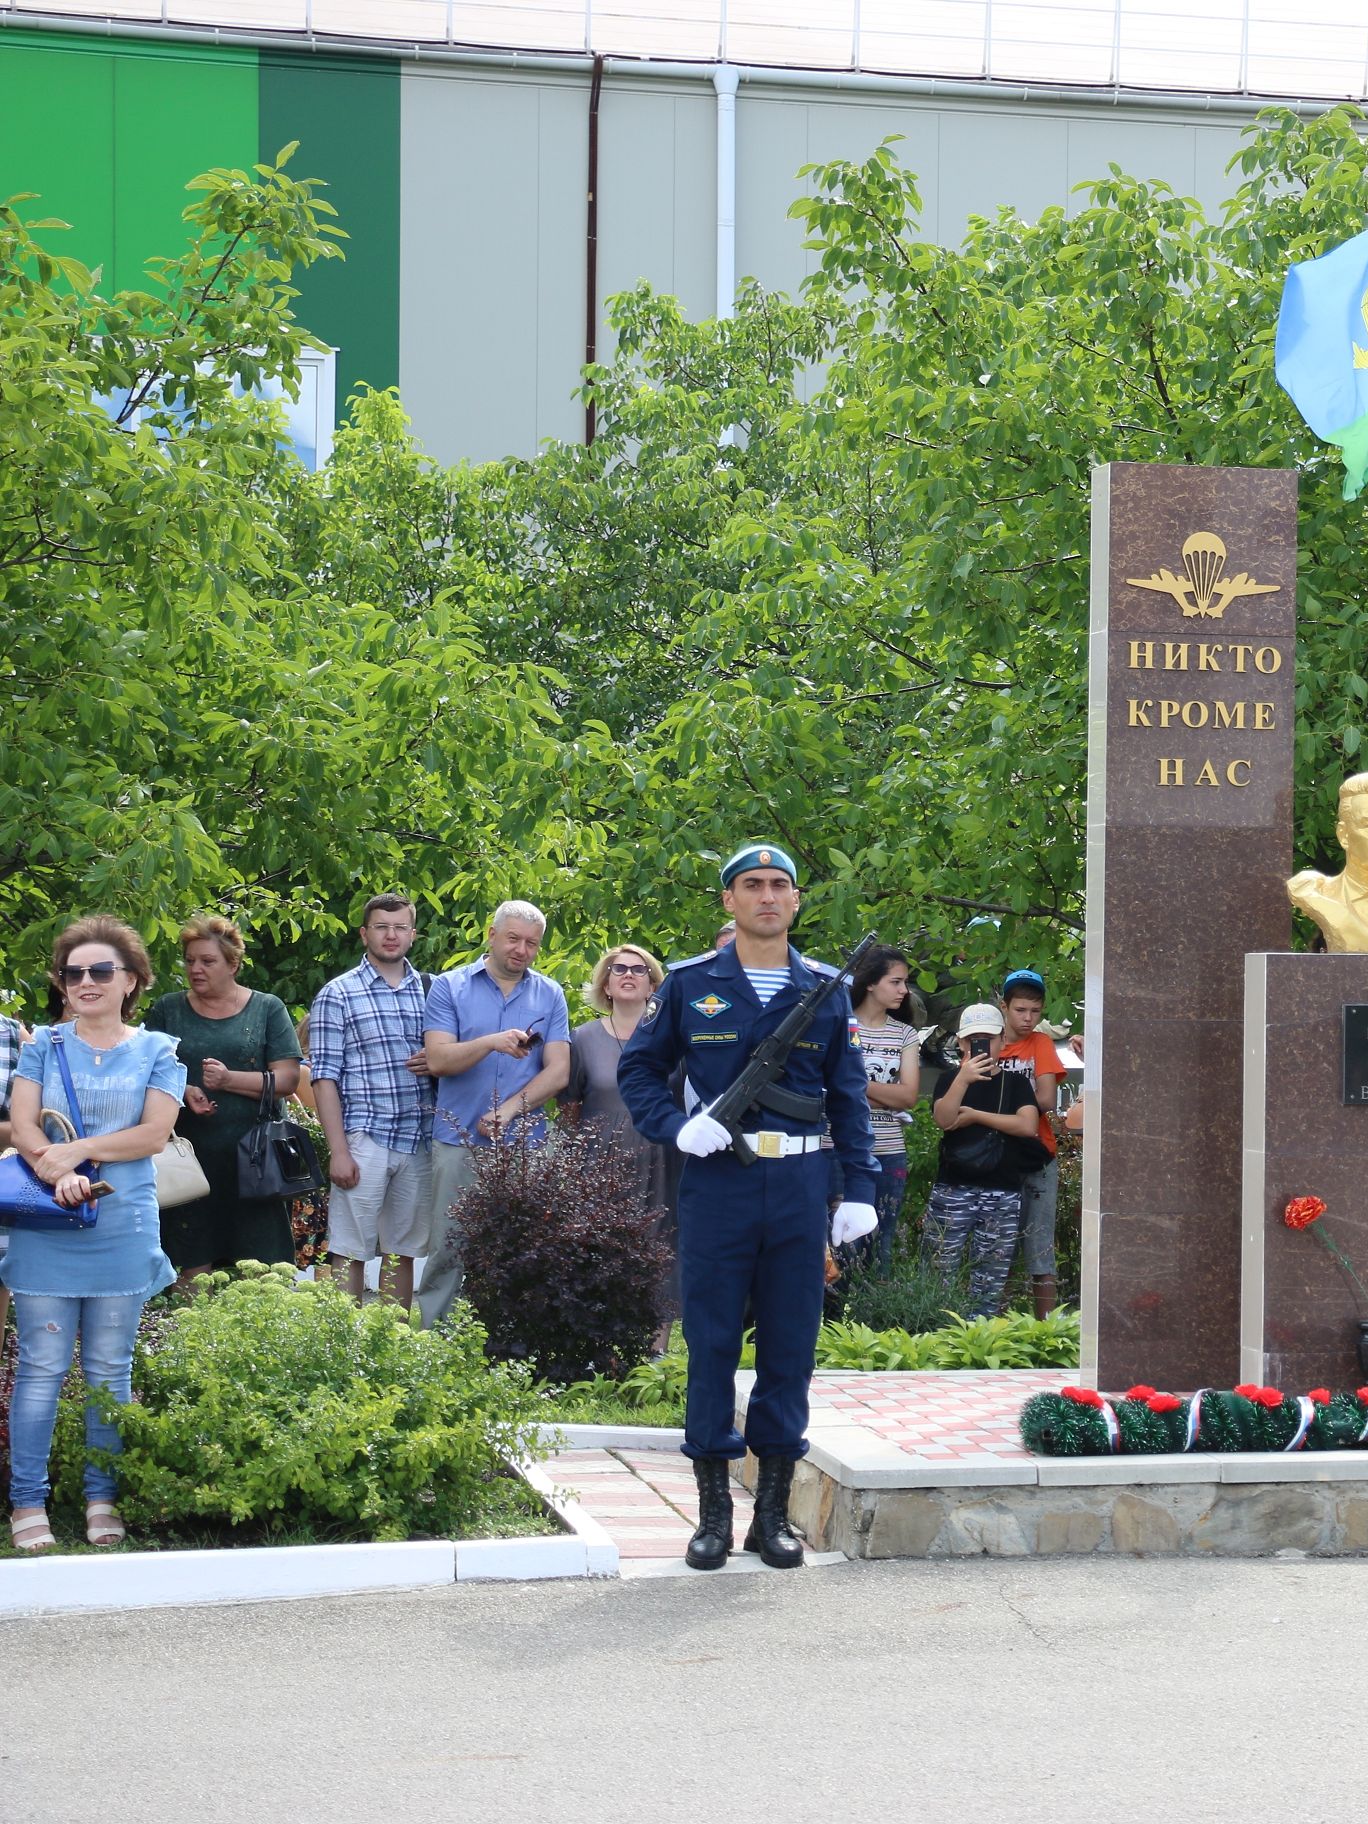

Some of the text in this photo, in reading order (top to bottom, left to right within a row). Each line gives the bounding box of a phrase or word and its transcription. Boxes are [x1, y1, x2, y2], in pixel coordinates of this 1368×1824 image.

[1127, 640, 1282, 674] НИКТО
[1127, 699, 1276, 730] КРОМЕ
[1157, 758, 1252, 787] НАС
